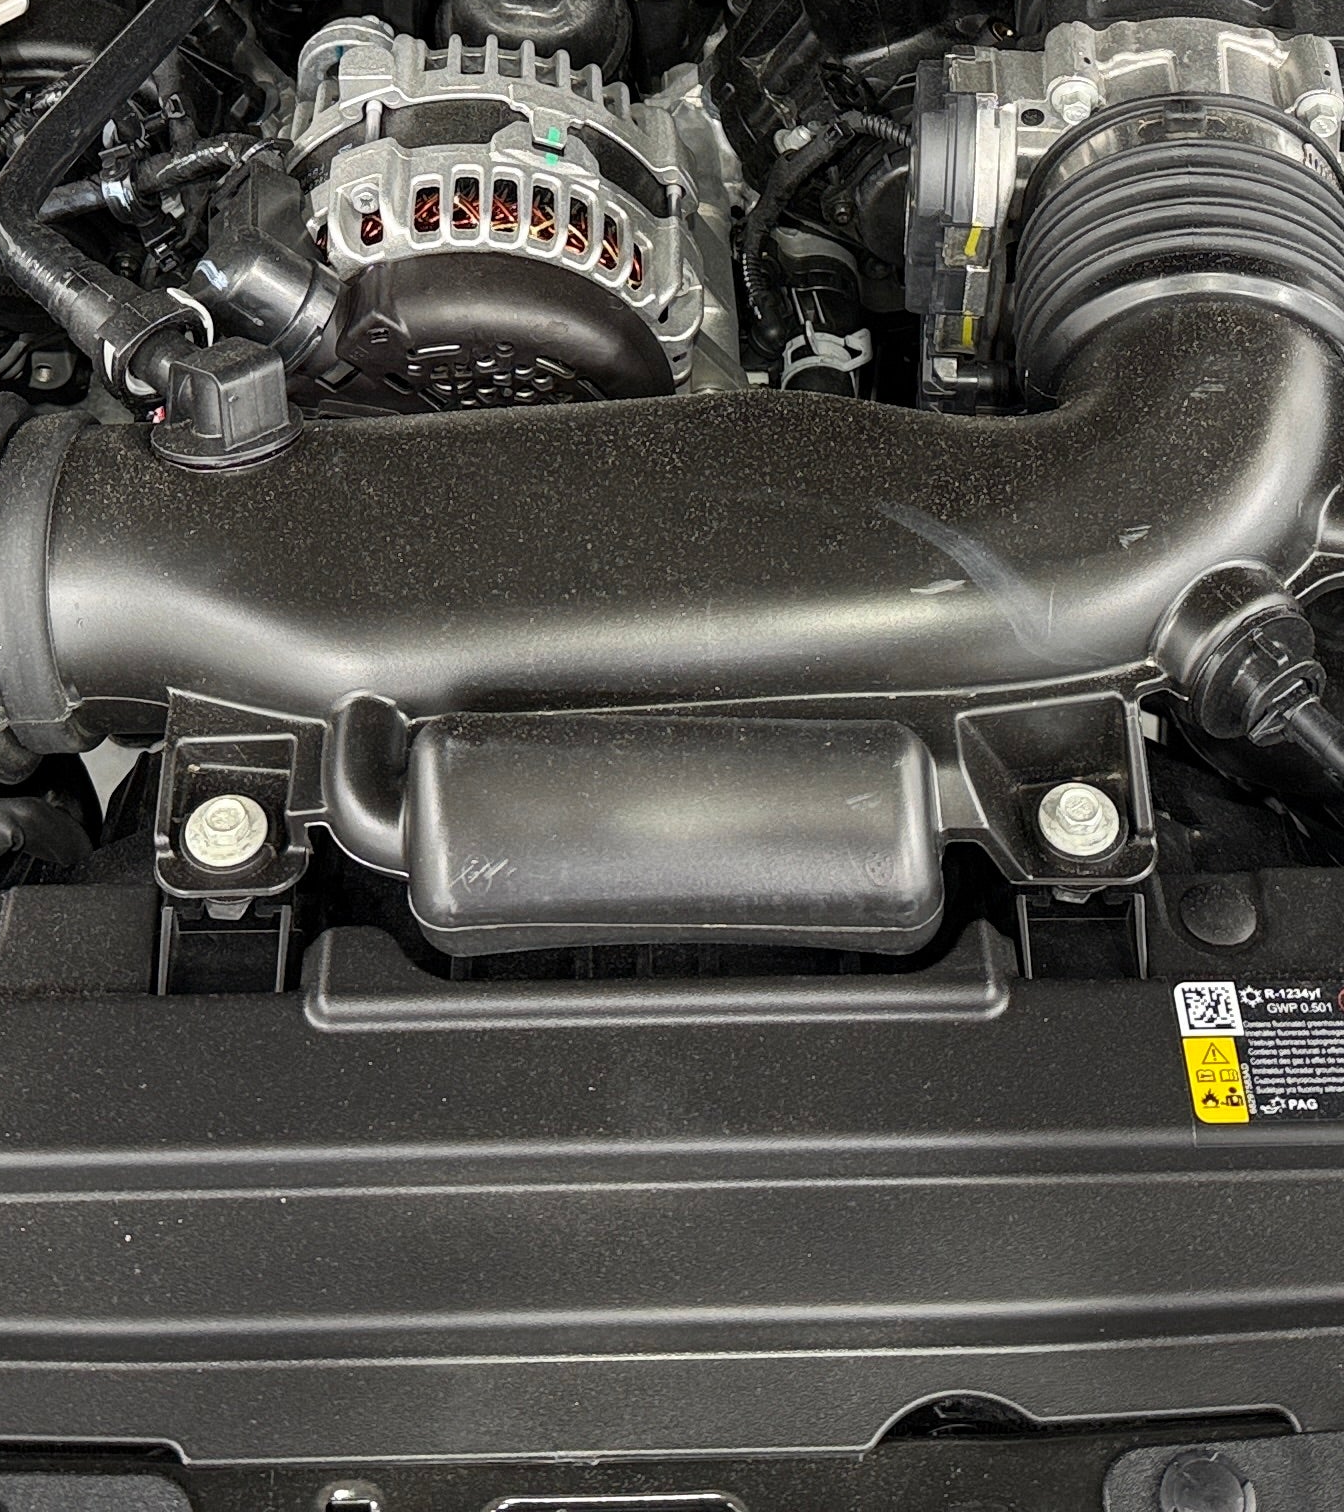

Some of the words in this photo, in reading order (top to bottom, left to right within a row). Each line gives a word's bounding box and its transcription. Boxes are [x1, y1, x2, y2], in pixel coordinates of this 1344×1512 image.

[1267, 1003, 1298, 1013] GWP
[1300, 1002, 1333, 1013] 0.501
[1288, 1098, 1318, 1110] PAG
